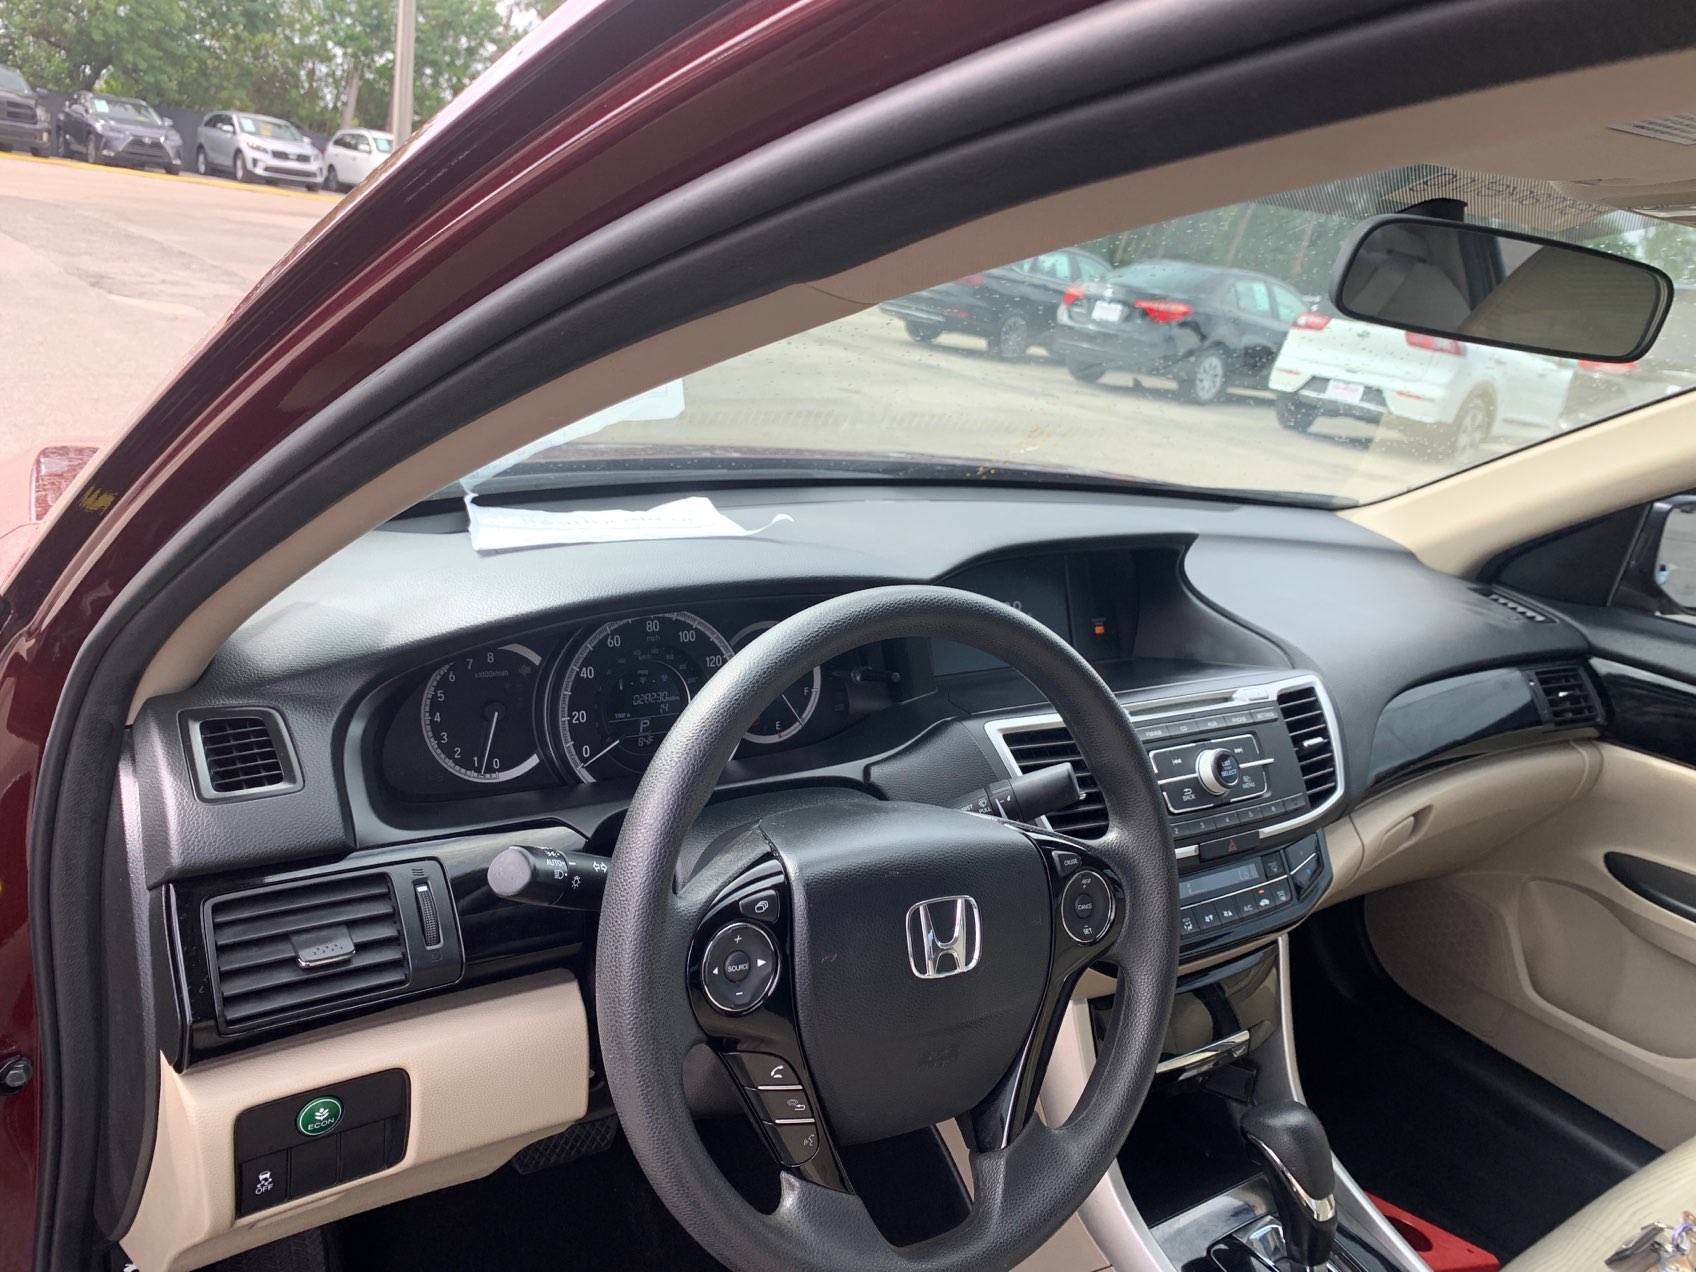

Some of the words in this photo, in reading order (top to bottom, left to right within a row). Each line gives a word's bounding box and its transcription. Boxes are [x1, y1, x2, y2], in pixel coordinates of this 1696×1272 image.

[646, 620, 660, 632] 80
[607, 635, 621, 648] 60
[678, 630, 696, 642] 100
[487, 652, 495, 663] 8
[705, 655, 723, 668] 120
[466, 658, 474, 670] 7
[448, 671, 456, 682] 6
[579, 666, 595, 679] 40
[437, 690, 445, 702] 5
[803, 686, 809, 696] F
[434, 712, 441, 723] 4
[571, 711, 587, 724] 20
[639, 719, 650, 733] P
[775, 721, 781, 730] E
[440, 732, 448, 744] 3
[454, 747, 461, 758] 2
[582, 745, 590, 758] 0
[473, 756, 478, 767] 1
[492, 758, 500, 769] 0
[1220, 768, 1237, 777] SELECT
[1182, 794, 1196, 802] BACK
[546, 858, 563, 867] AUTO
[727, 963, 749, 973] SOURCE
[307, 1117, 335, 1131] ECON
[255, 1182, 274, 1195] OFF
